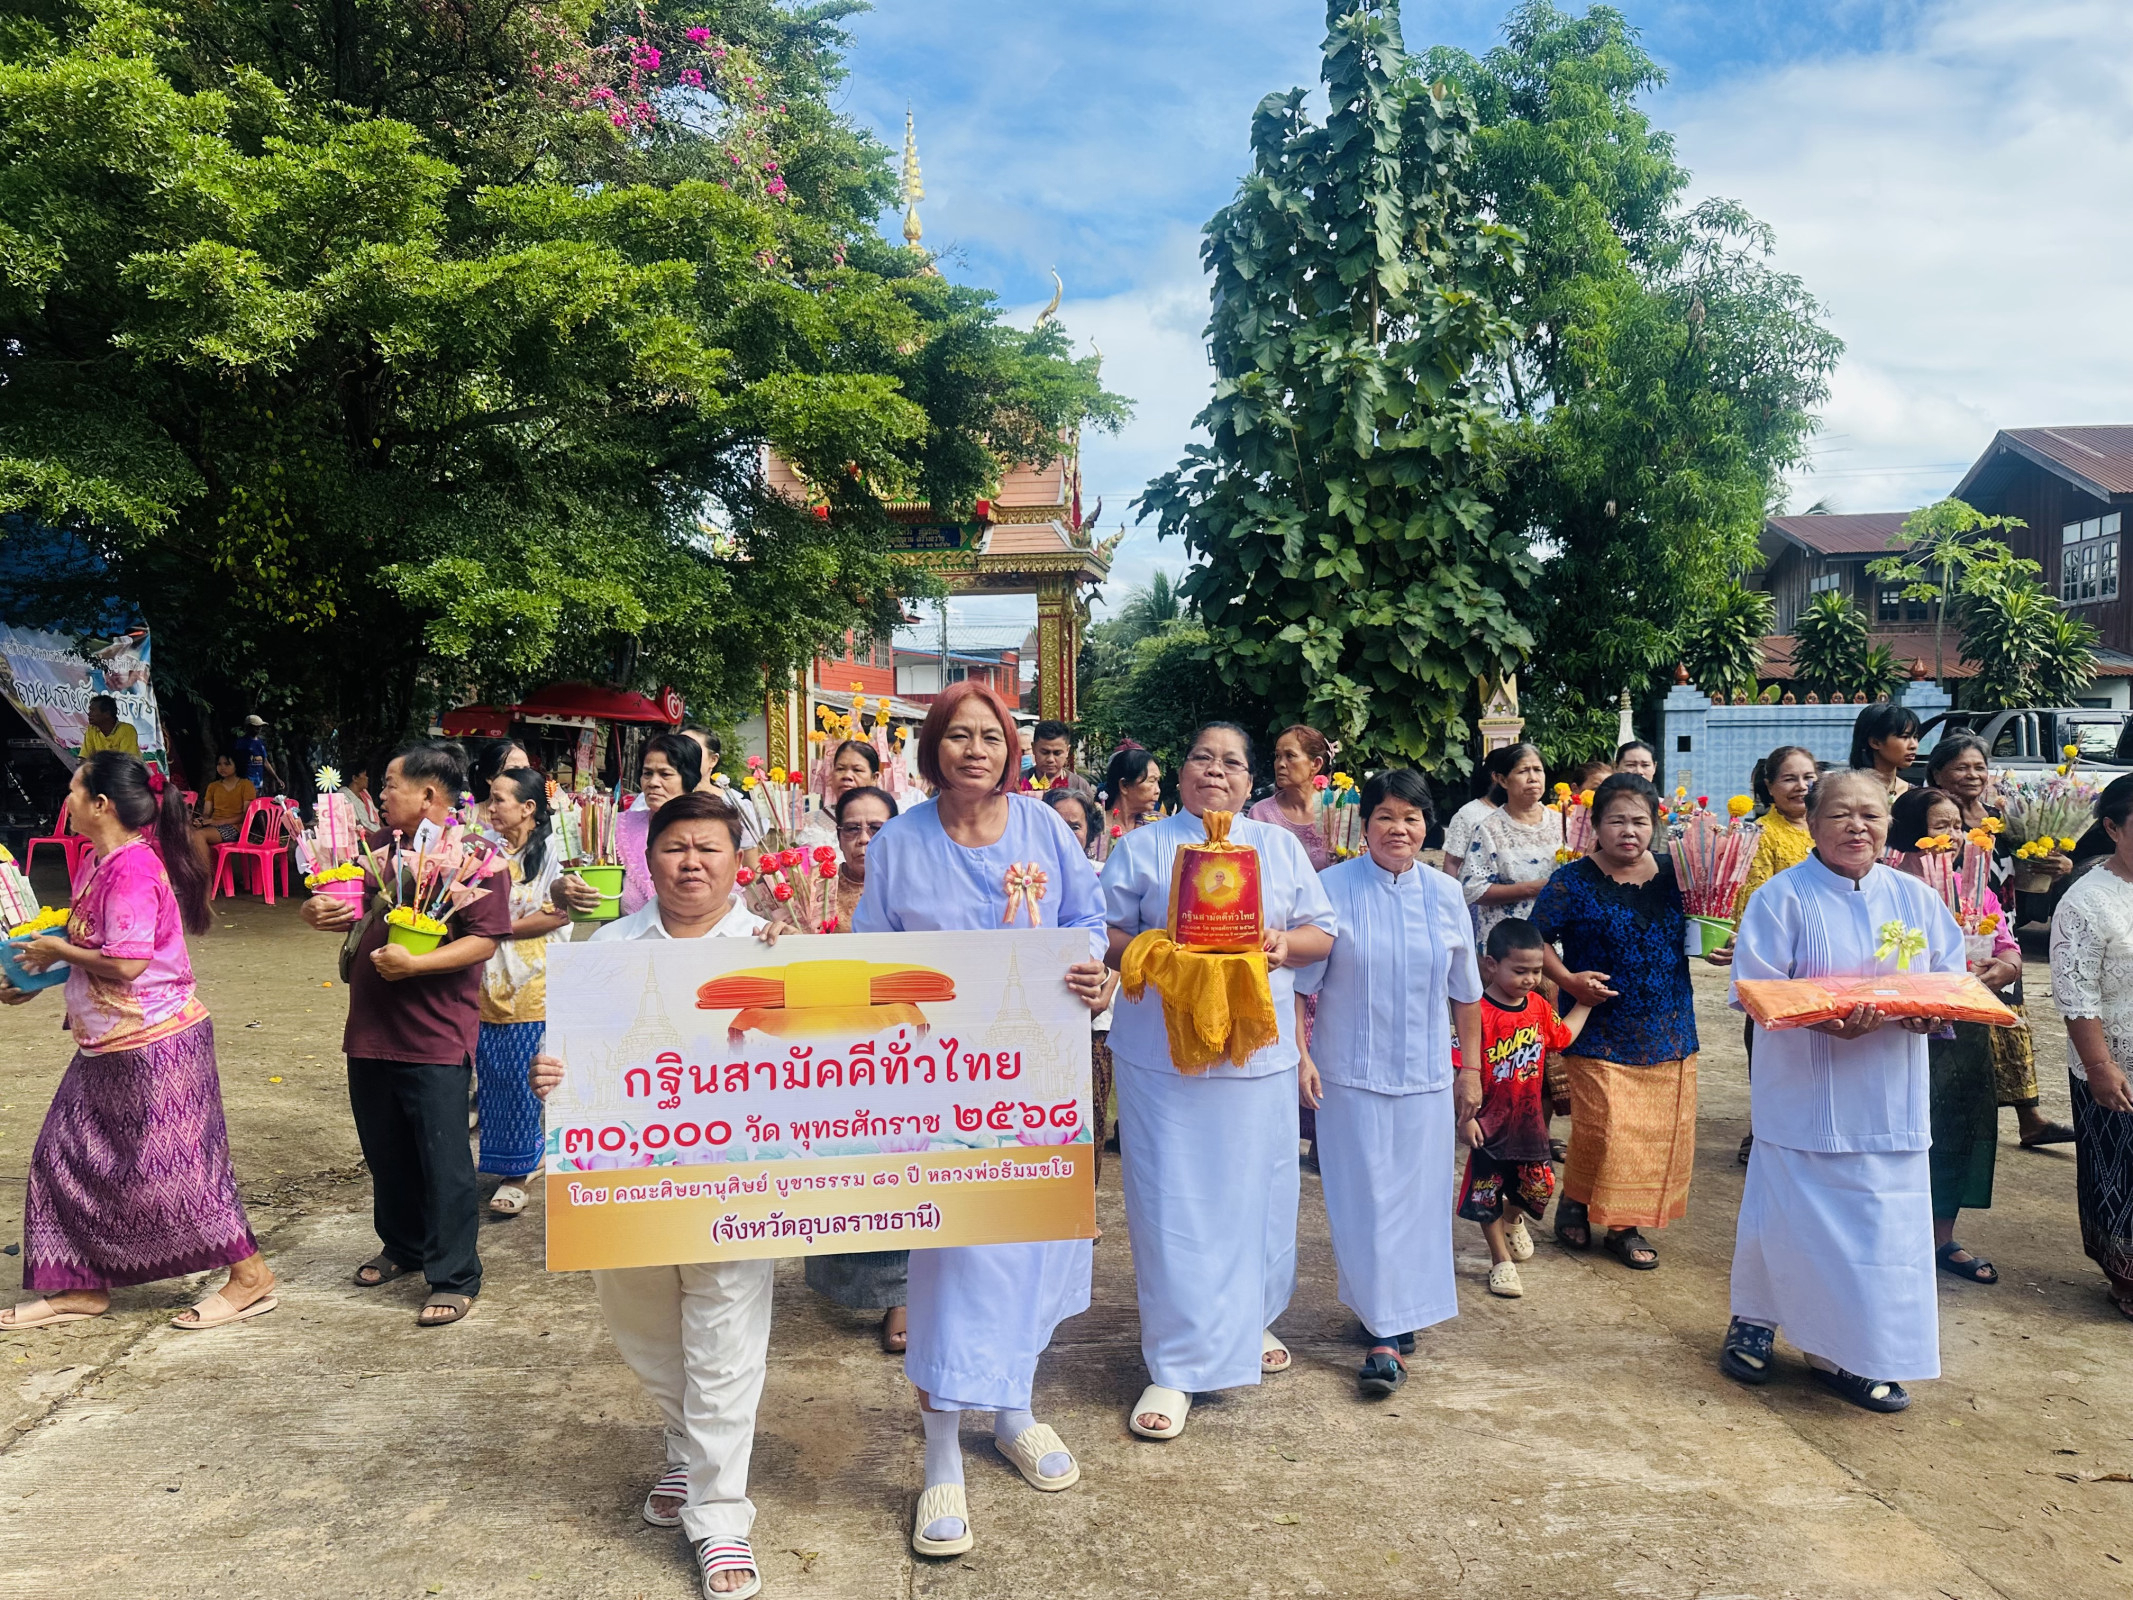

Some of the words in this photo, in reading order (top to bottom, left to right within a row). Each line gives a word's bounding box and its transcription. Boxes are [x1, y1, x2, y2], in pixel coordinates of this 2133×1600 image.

[624, 1029, 1021, 1110] กฐินสามัคคีทั่วไทย
[565, 1120, 732, 1156] ๓๐,๐๐๐
[745, 1114, 780, 1143] วัด
[790, 1109, 941, 1150] พุทธศักราช
[953, 1099, 1078, 1131] ๒๕๖๘
[570, 1184, 607, 1204] โดย
[616, 1173, 768, 1201] คณะศิษยานุศิษย์
[776, 1172, 865, 1197] บูชาธรรม
[873, 1173, 899, 1187] ๘๑
[907, 1165, 920, 1184] ปี
[928, 1158, 1073, 1183] หลวงพ่อธัมมชโย
[712, 1202, 941, 1244] (จังหวัดอุบลราชธานี)
